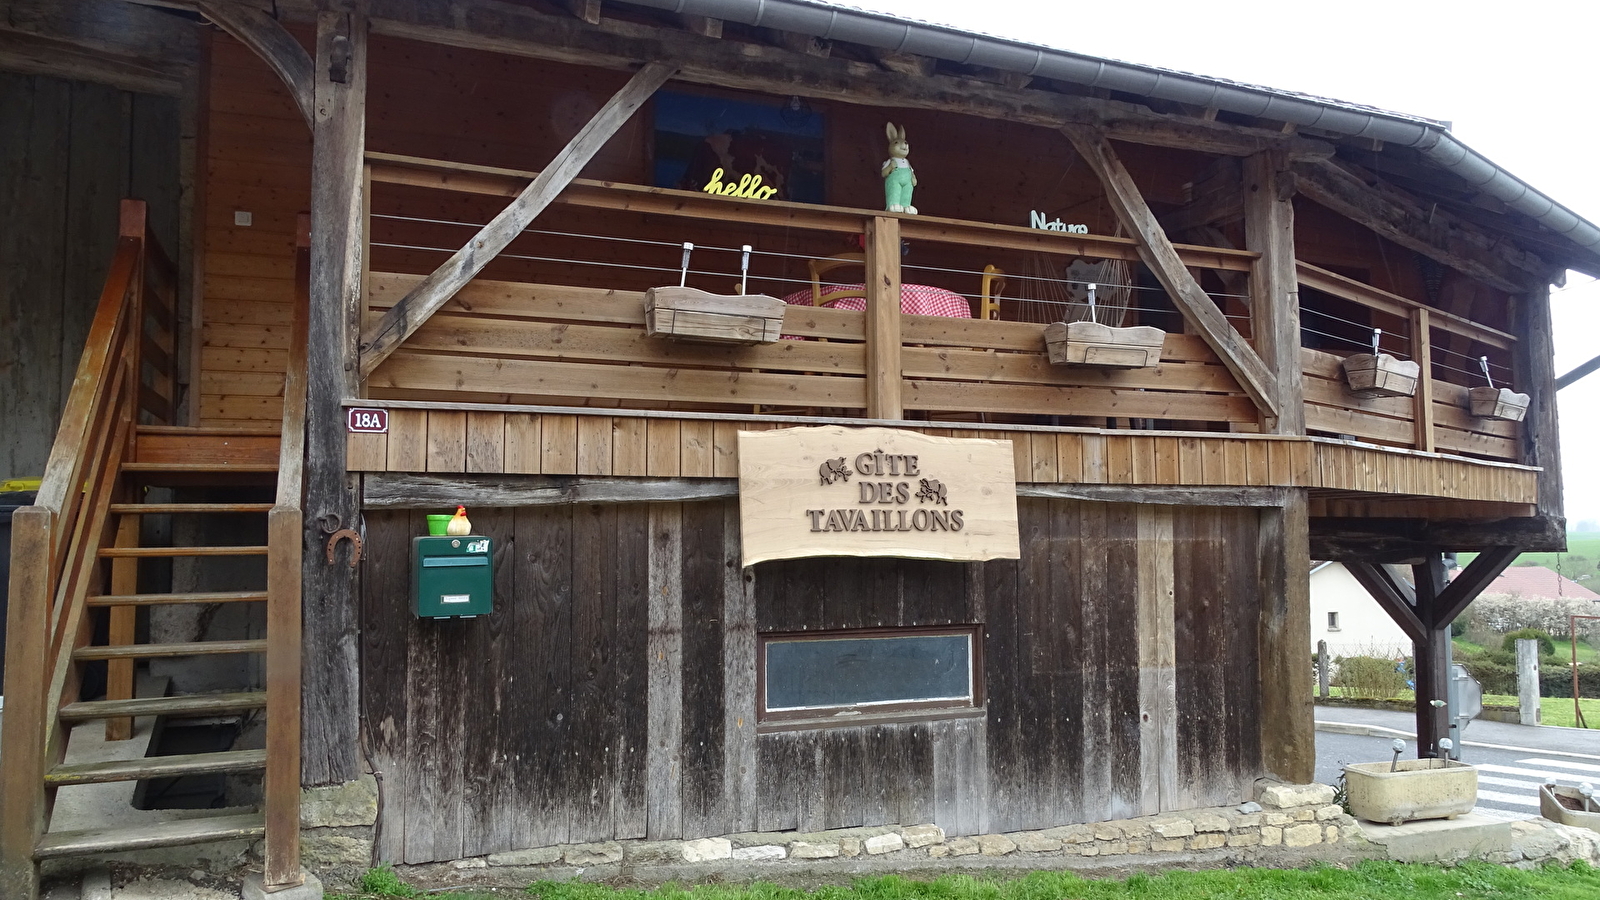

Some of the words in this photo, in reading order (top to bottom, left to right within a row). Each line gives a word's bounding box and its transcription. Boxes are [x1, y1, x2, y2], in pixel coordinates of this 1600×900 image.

[703, 167, 778, 200] hello
[1030, 209, 1089, 234] Nature
[355, 412, 382, 428] 18A
[855, 448, 920, 477] GÎTE
[858, 481, 911, 505] DES
[806, 509, 965, 533] TAVAILLONS
